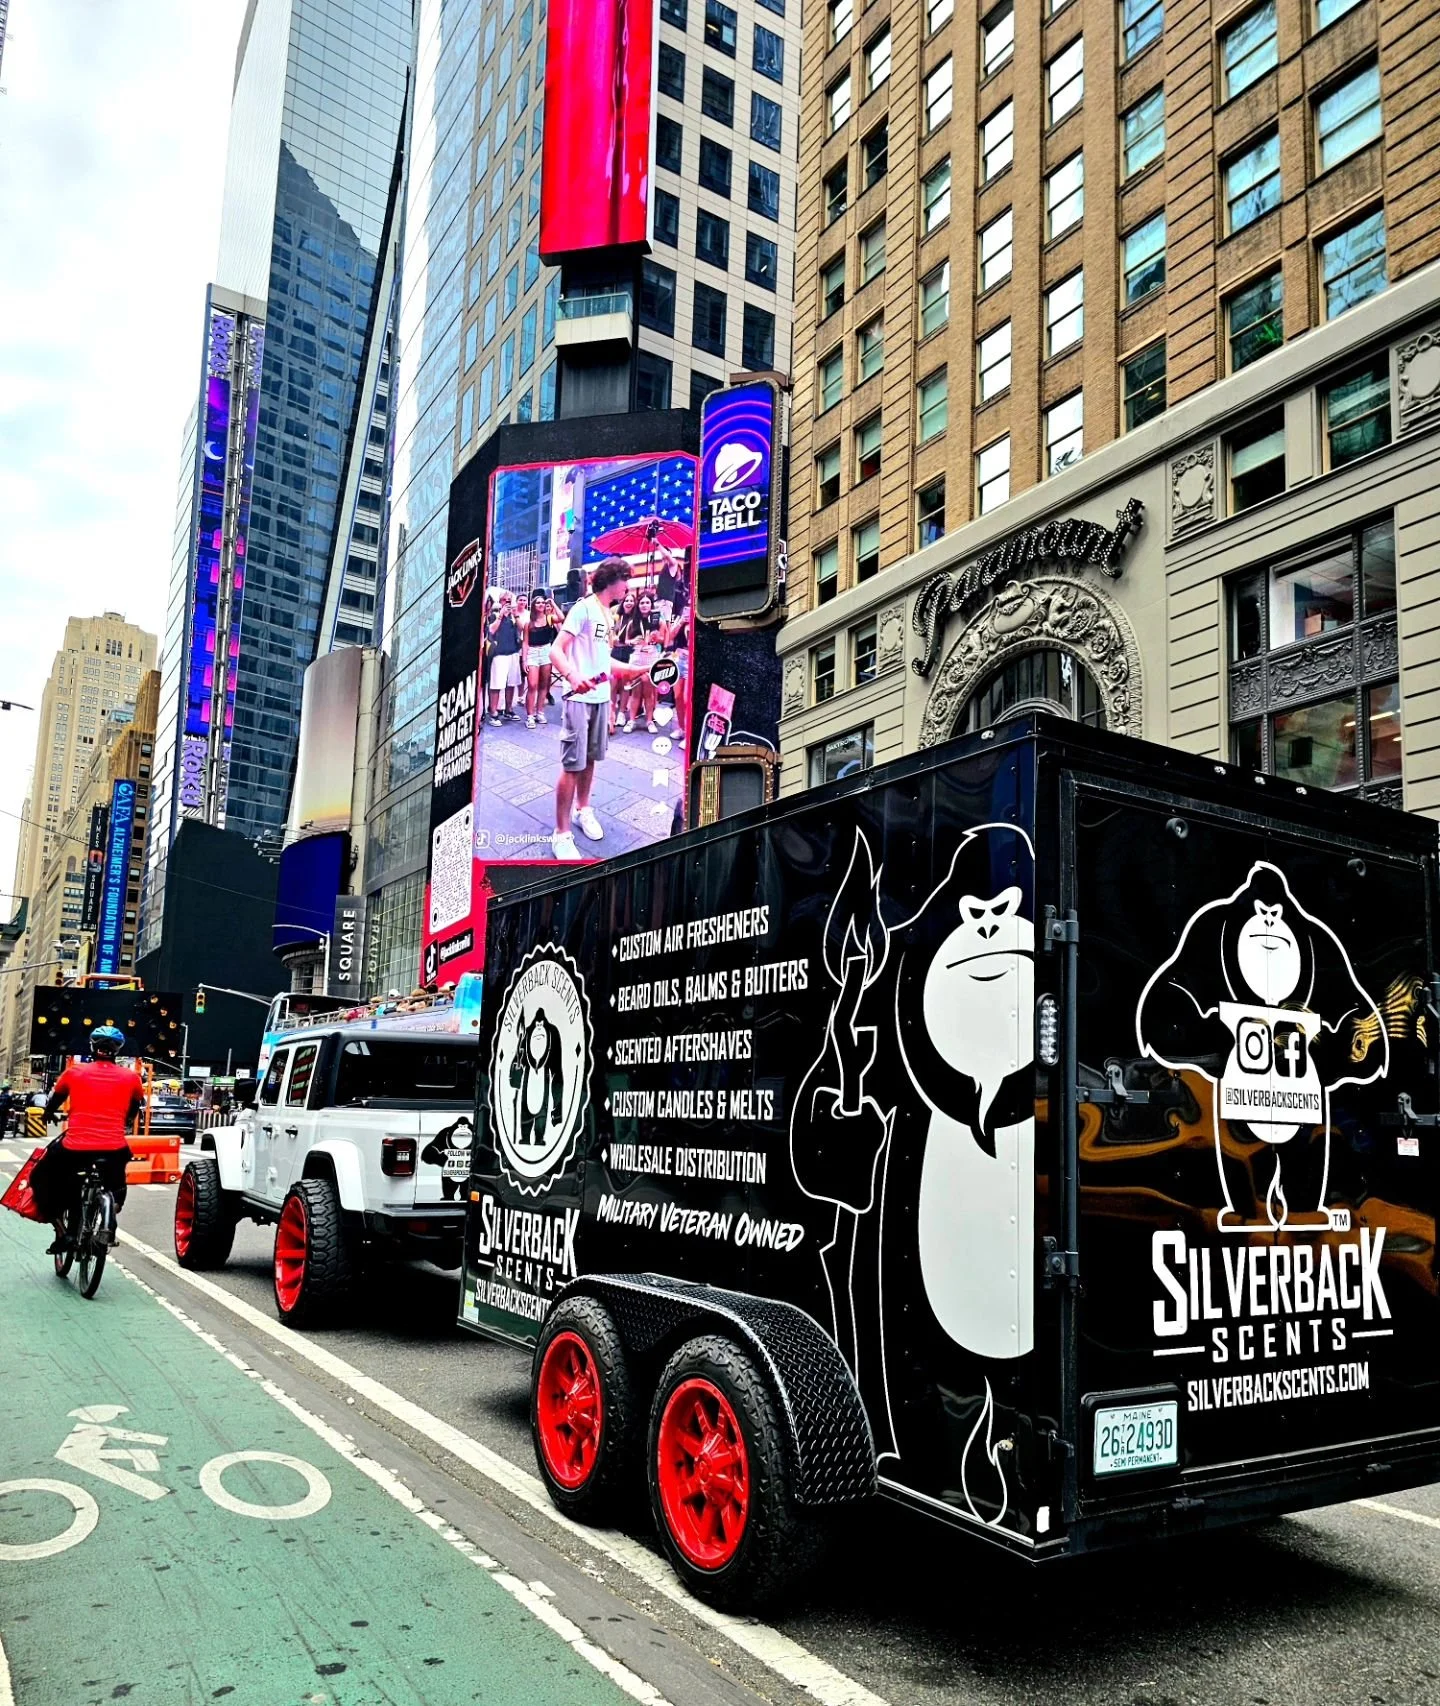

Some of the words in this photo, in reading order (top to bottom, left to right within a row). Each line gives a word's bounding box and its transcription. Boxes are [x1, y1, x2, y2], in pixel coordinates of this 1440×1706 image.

[708, 491, 761, 516] TACO
[711, 510, 762, 534] BELL
[912, 498, 1144, 676] Paramount
[653, 666, 675, 682] WILD
[439, 670, 476, 729] SCAN
[437, 721, 457, 755] AND
[457, 708, 475, 740] GET
[443, 751, 472, 784] FAMOUS
[95, 809, 103, 848] TIMES
[109, 827, 126, 884] ALZHEIMER'S
[87, 875, 96, 921] SQUARE
[103, 887, 120, 941] FOUNDATION
[102, 944, 114, 955] OF
[339, 910, 356, 981] SQUARE
[620, 929, 662, 962] CUSTOM
[664, 924, 684, 953] AIR
[686, 905, 769, 949] FRESHENERS
[504, 964, 551, 1033] SILVERBACK
[551, 966, 581, 1025] SCENTS
[617, 982, 651, 1012] BEARD
[653, 978, 682, 1007] OILS,
[685, 971, 728, 1004] BALMS
[731, 969, 741, 998] &
[744, 958, 809, 997] BUTTERS
[614, 1036, 662, 1065] SCENTED
[663, 1029, 752, 1063] AFTERSHAVES
[612, 1091, 655, 1118] CUSTOM
[657, 1090, 713, 1119] CANDLES
[716, 1090, 726, 1119] &
[729, 1089, 774, 1121] MELTS
[1226, 1087, 1320, 1110] @SILVERBACKSCENTS
[610, 1143, 672, 1175] WHOLESALE
[675, 1147, 766, 1184] DISTRIBUTION
[479, 1194, 580, 1278] SILVERBACK
[597, 1193, 658, 1229] MILITARY
[659, 1202, 733, 1241] VETERAN
[734, 1212, 805, 1252] OWNED
[1333, 1213, 1348, 1227] TM
[496, 1255, 554, 1291] SCENTS
[1152, 1226, 1392, 1337] SILVERBACK
[1212, 1317, 1346, 1363] SCENTS
[1187, 1361, 1370, 1412] SILVERBACKSCENTS.COM
[1123, 1410, 1152, 1420] MAINE
[1113, 1458, 1127, 1468] SEMI
[1127, 1453, 1160, 1466] PERMANENT
